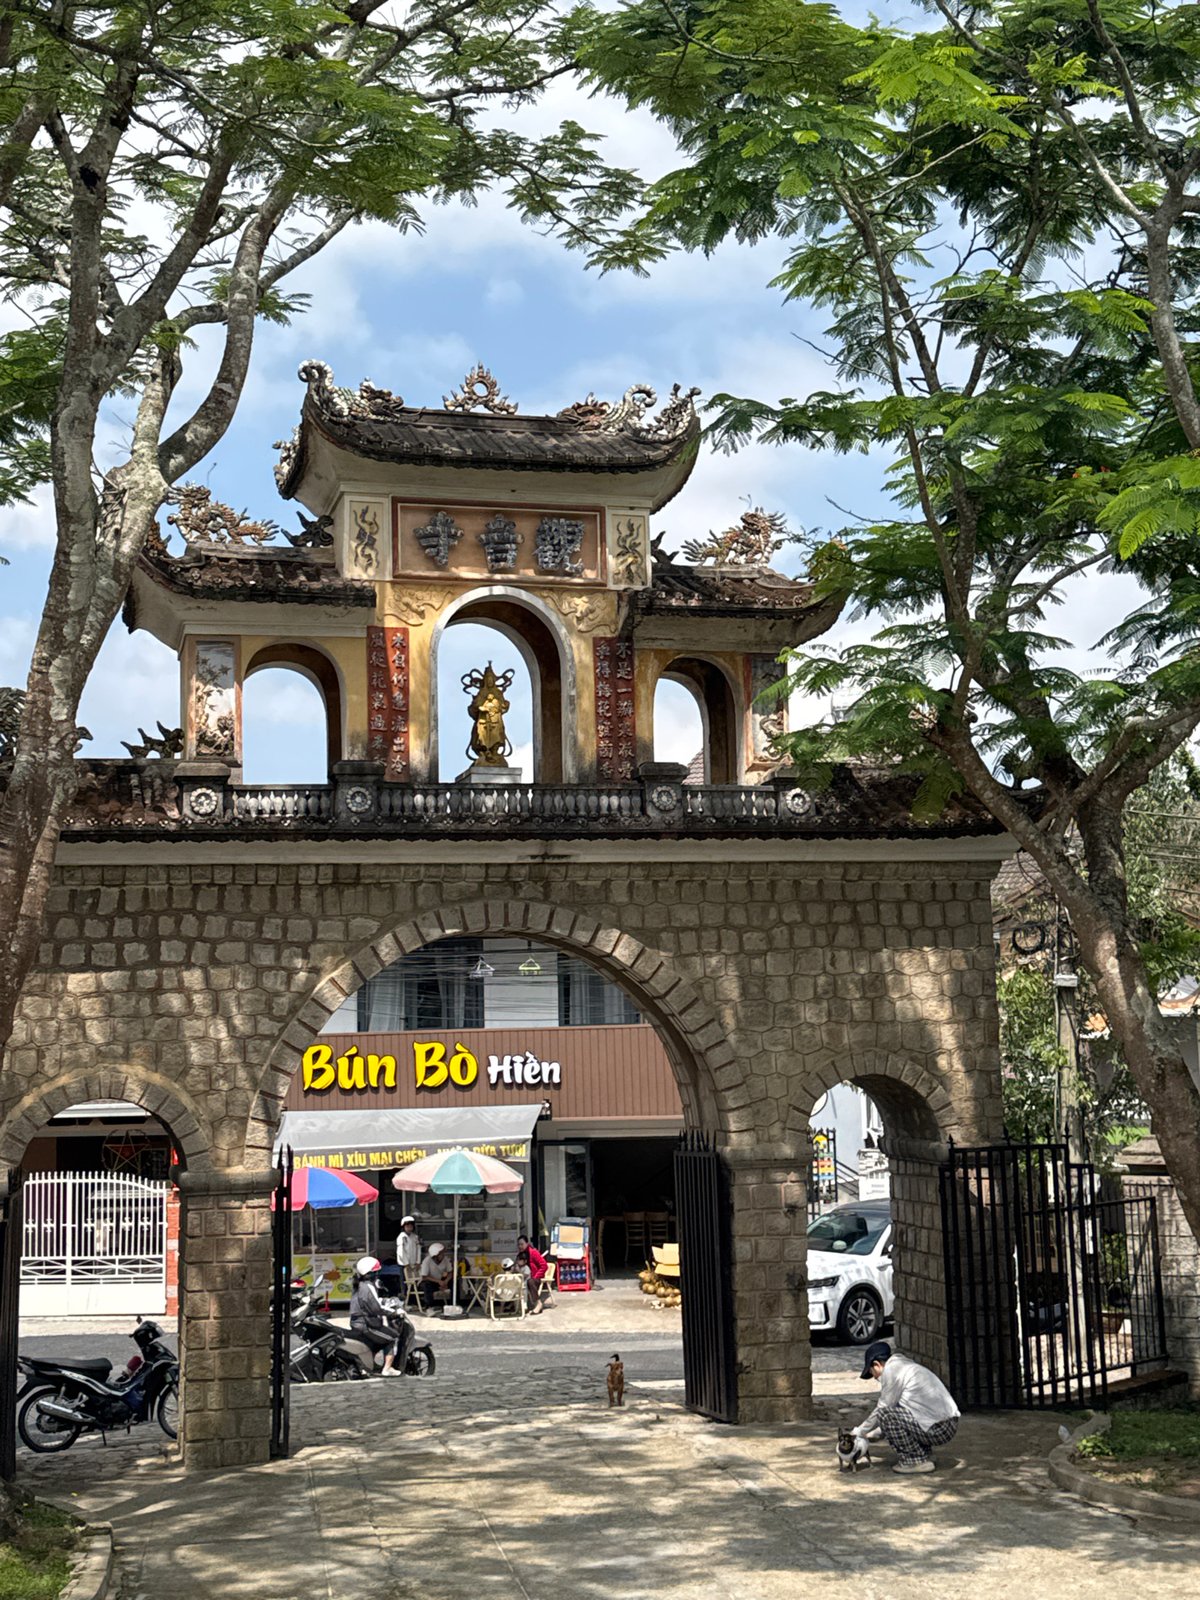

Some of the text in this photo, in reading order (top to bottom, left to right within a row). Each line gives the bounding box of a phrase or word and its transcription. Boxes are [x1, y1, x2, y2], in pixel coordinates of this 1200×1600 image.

[301, 1040, 561, 1091] Bún Bò Hiền
[293, 1153, 326, 1169] BÁNH
[328, 1151, 344, 1168] MÌ
[346, 1151, 367, 1167] XÍU
[369, 1151, 393, 1168] MẠI
